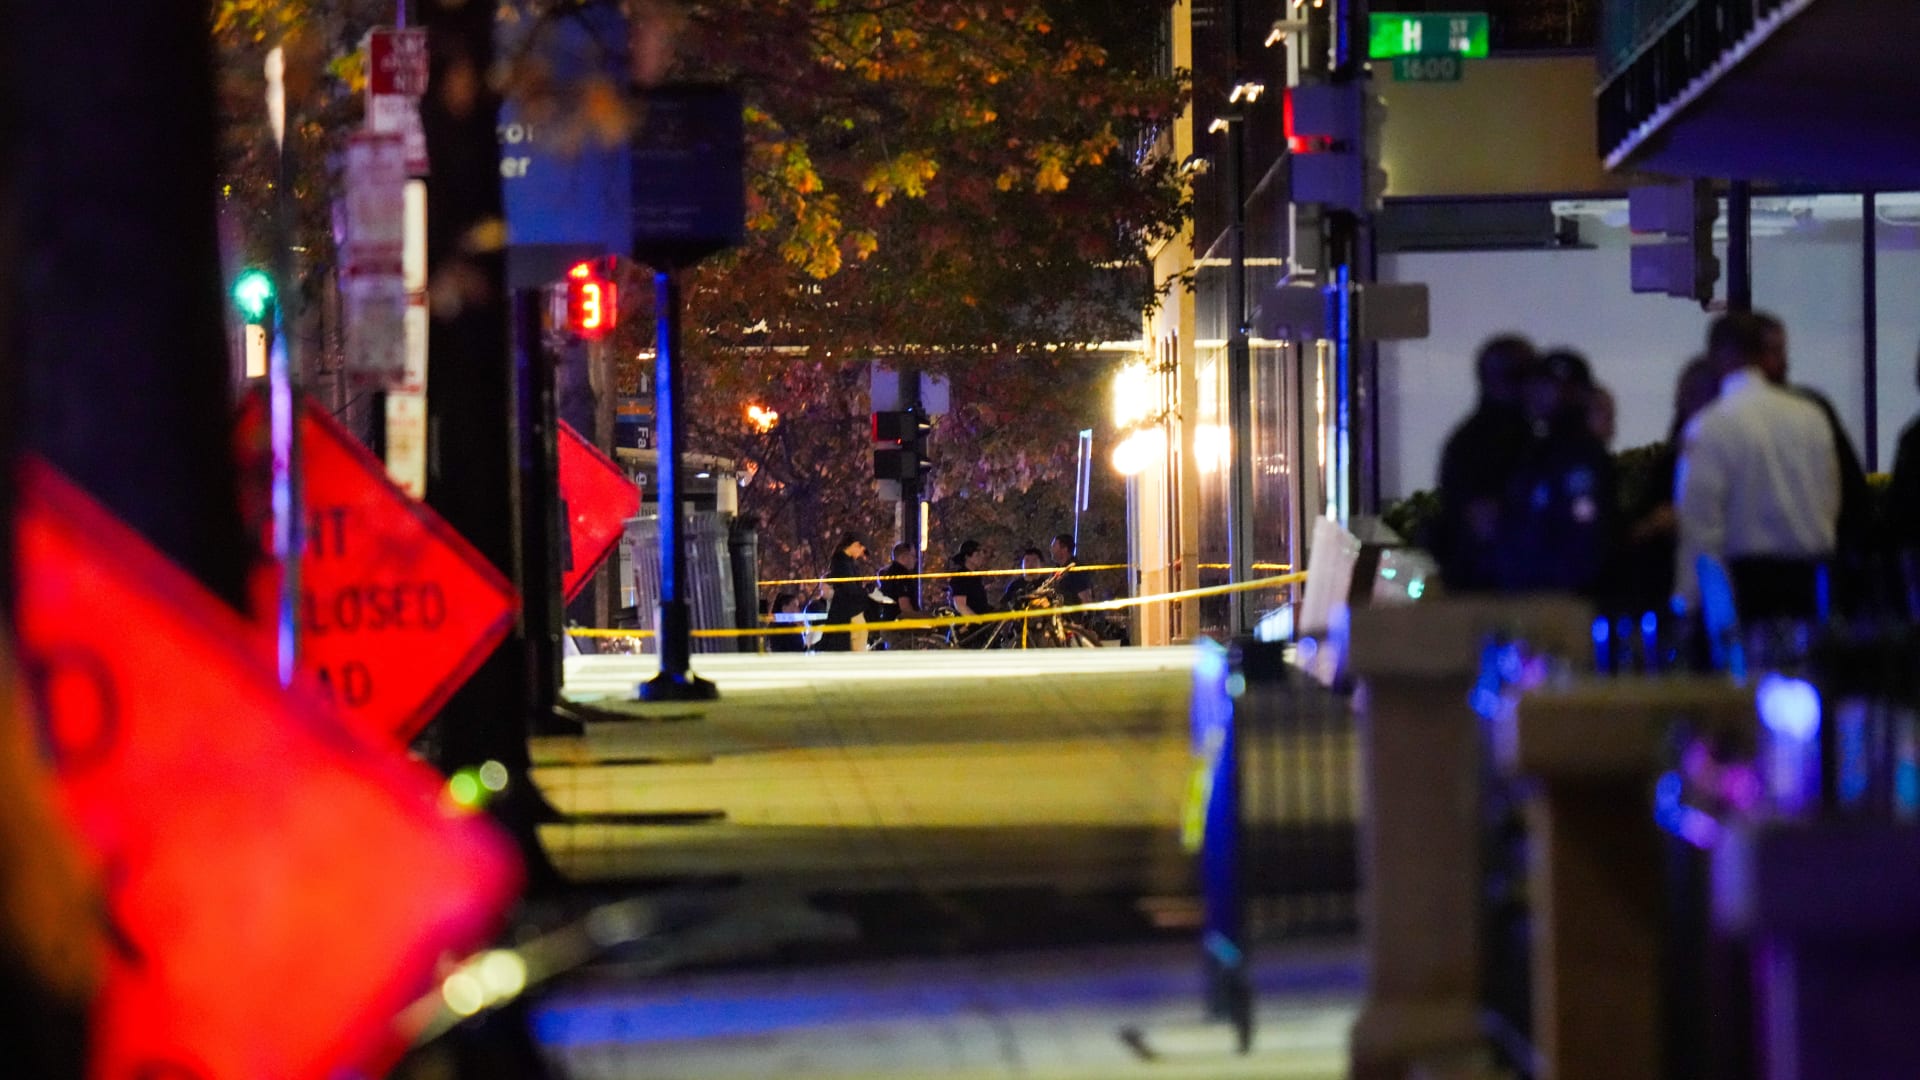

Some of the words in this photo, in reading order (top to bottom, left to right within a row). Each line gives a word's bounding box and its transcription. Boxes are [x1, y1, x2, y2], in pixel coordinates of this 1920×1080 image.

[1402, 19, 1422, 53] H
[1402, 58, 1457, 80] 1600
[581, 283, 601, 330] 3
